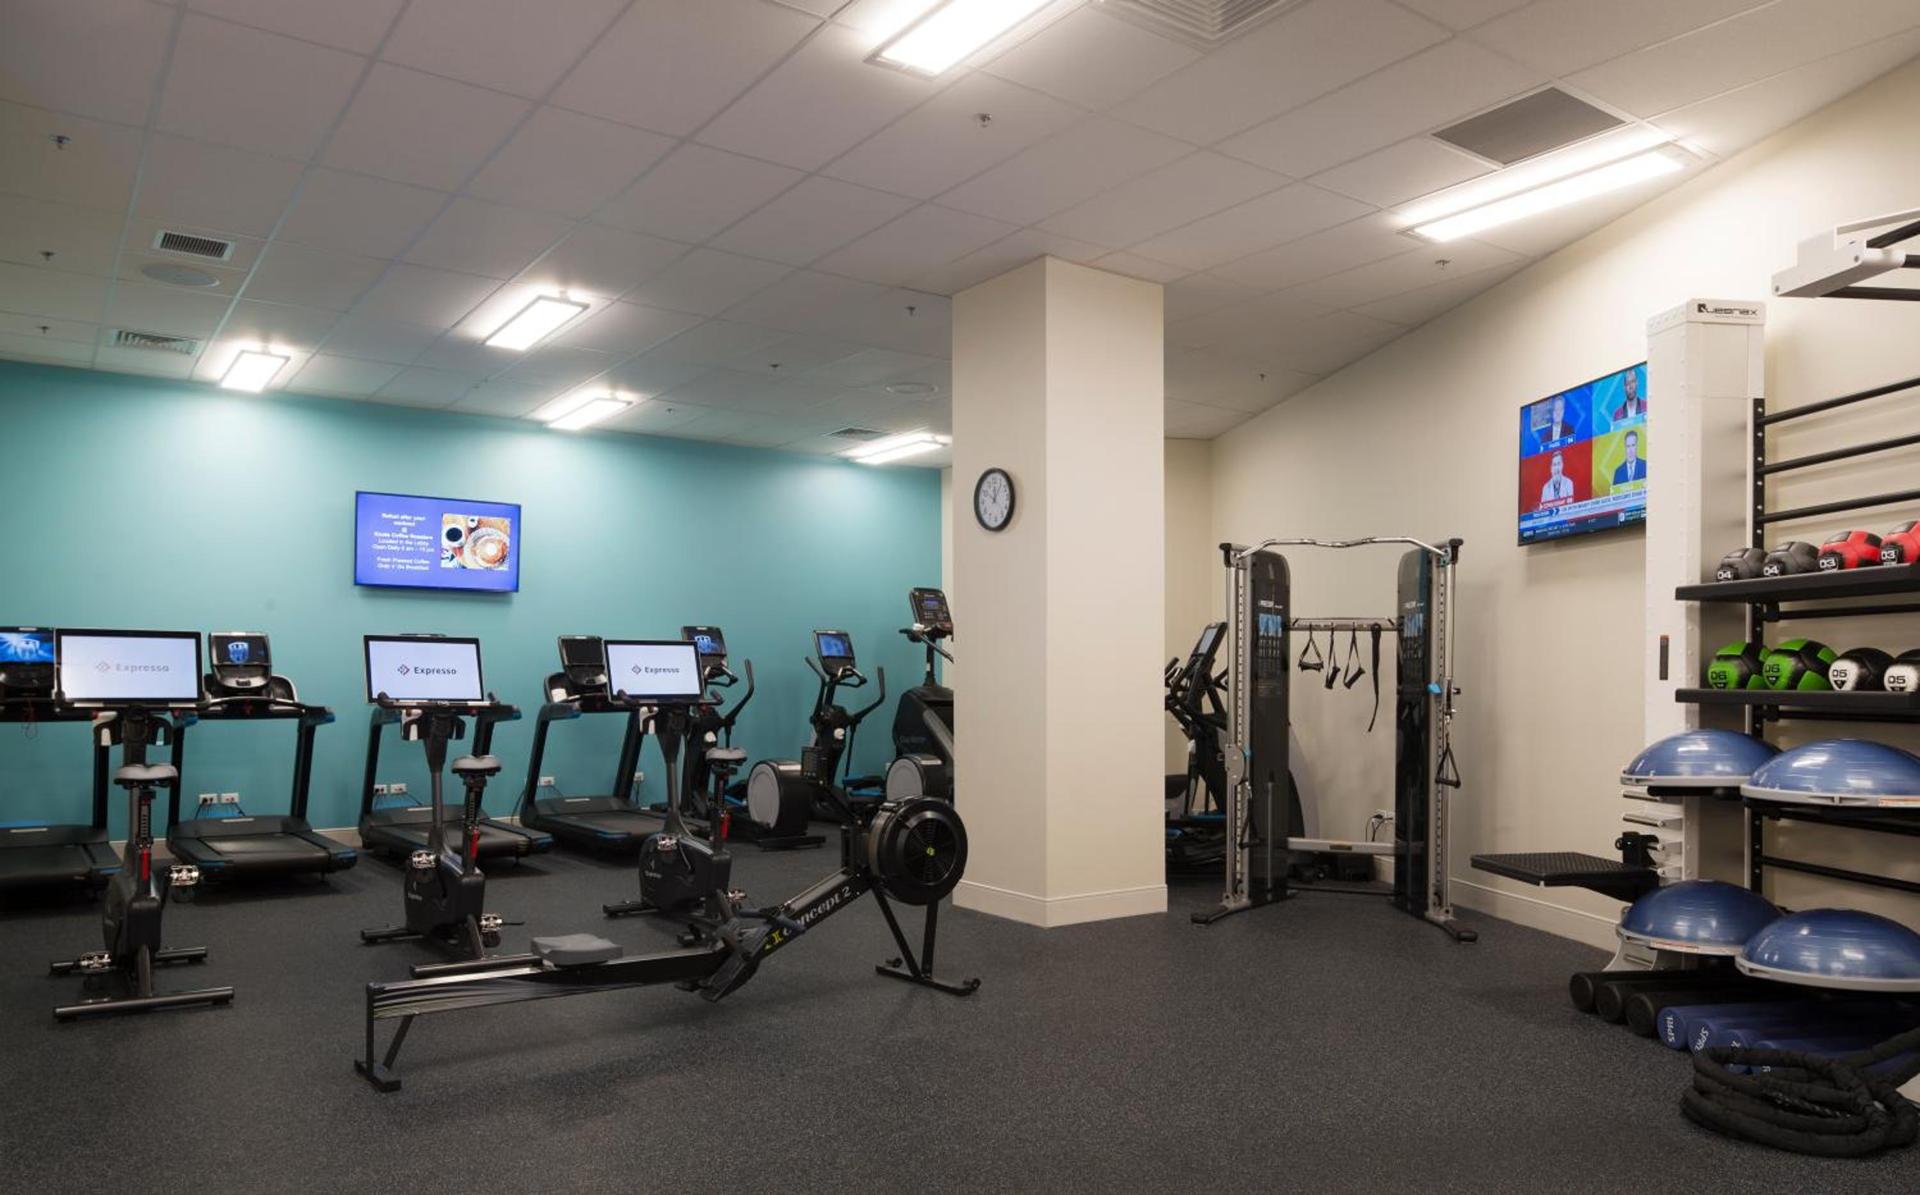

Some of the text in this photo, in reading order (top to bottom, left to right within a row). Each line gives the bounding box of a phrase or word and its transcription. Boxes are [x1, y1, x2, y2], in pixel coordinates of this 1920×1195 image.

[1881, 550, 1896, 560] 03
[1820, 558, 1837, 568] 03
[1717, 570, 1732, 580] 04
[1763, 565, 1780, 577] 04
[115, 663, 169, 673] Expresso
[414, 666, 457, 676] Expresso
[644, 666, 680, 675] Expresso
[1832, 669, 1848, 678] 05
[1888, 675, 1906, 684] 05
[783, 892, 842, 937] cncept
